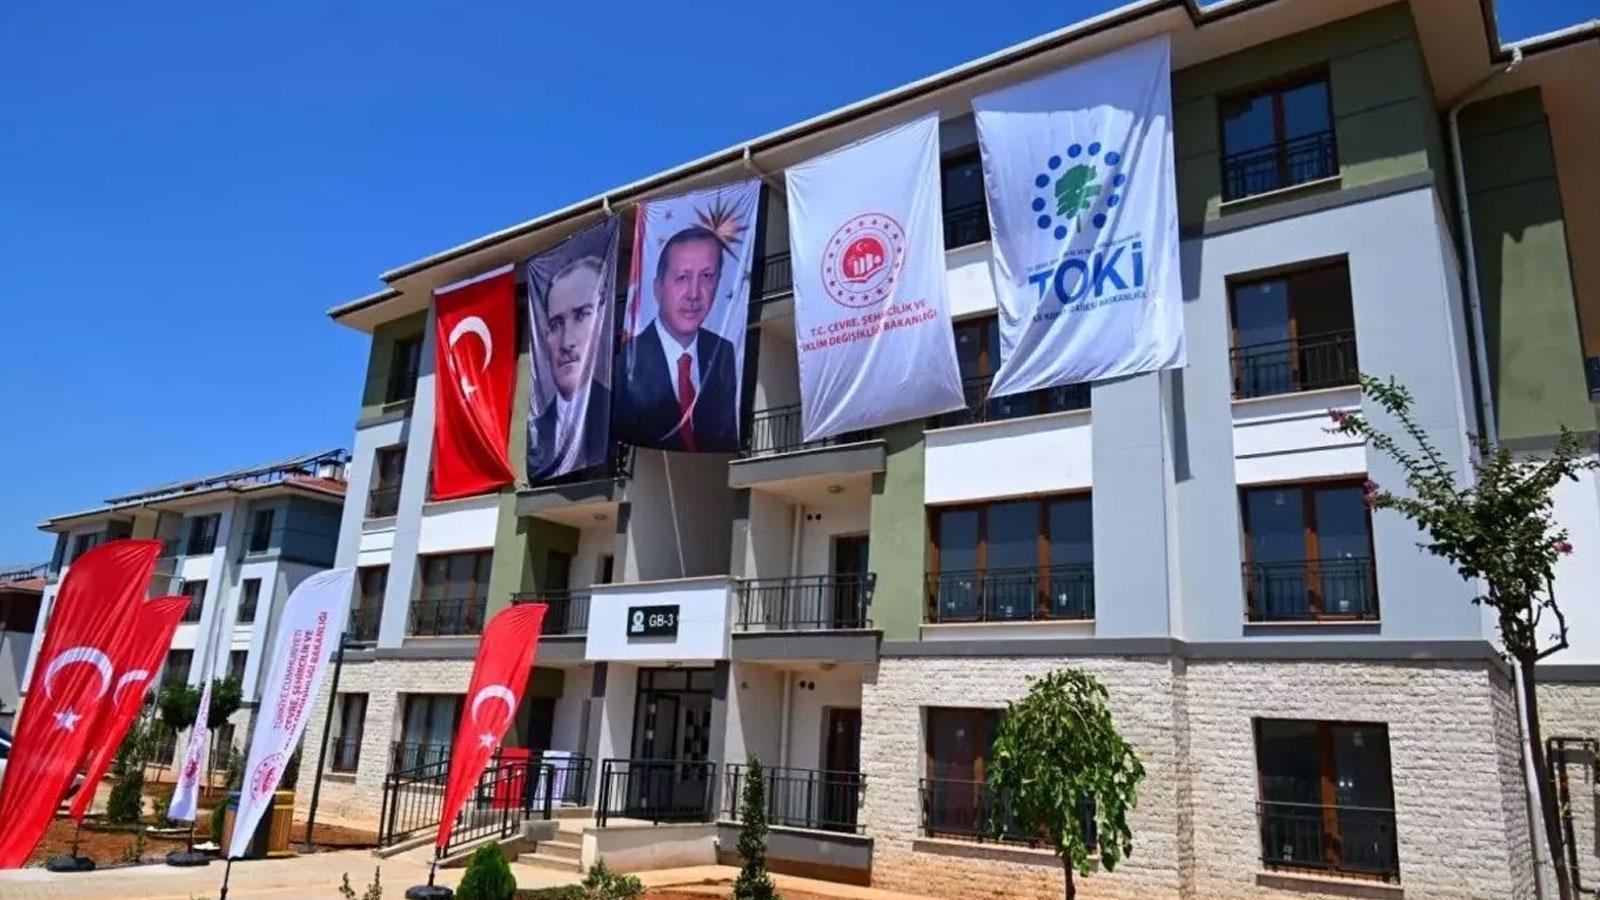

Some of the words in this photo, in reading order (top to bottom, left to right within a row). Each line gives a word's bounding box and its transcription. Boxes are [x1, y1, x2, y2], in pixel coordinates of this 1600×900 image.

[883, 308, 937, 331] BAKANLIĞI
[810, 325, 826, 337] T.C.
[648, 613, 674, 628] GB-3
[304, 629, 314, 642] VE
